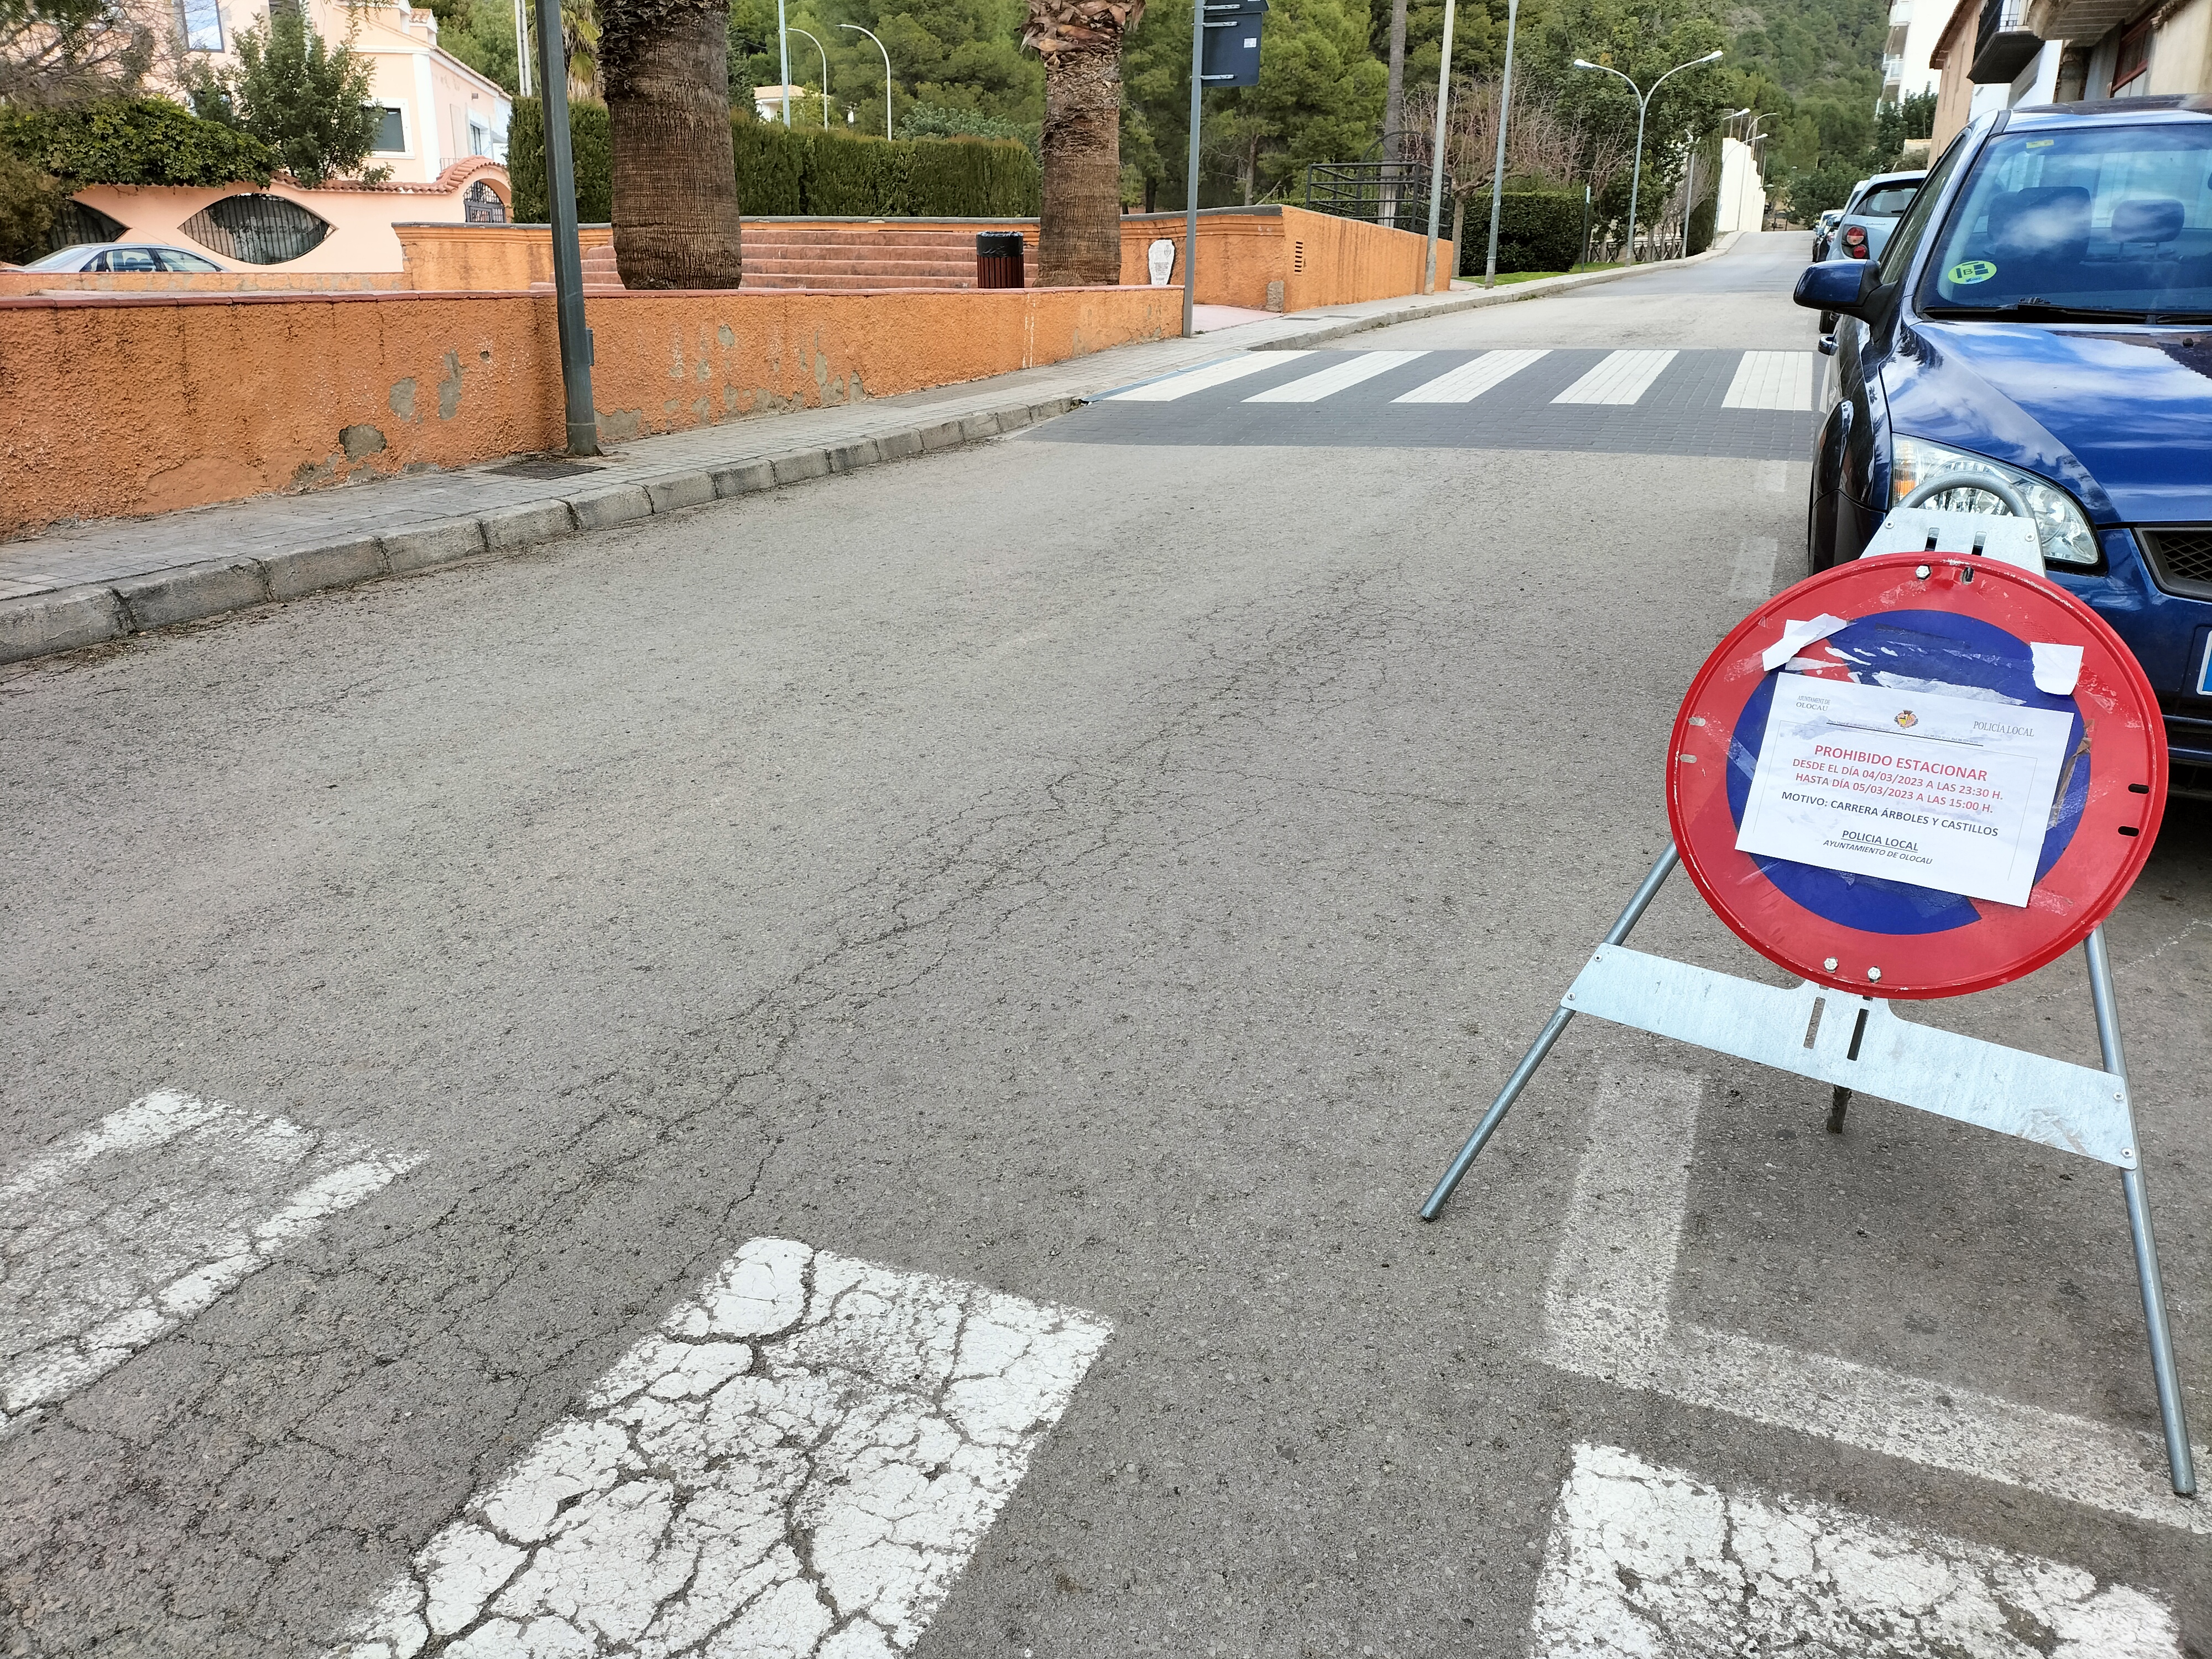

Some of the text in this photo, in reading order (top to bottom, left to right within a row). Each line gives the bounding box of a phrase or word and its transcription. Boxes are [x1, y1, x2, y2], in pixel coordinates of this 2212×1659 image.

[1796, 702, 1828, 711] OLOCAU
[1797, 695, 1824, 704] AJUNTAMENT
[1973, 721, 2034, 737] POLICÍA LOCAL
[1814, 745, 1987, 781] PROHIBIDO ESTACIONAR
[1793, 759, 2003, 800] DESDE EL DÍA 04/03/2023 A LAS 23:30 H.
[1796, 773, 1993, 813] HASTA DÍA 05/03/2023 A LAS 15:00 H.
[1781, 791, 1999, 837] MOTIVO: CARRERA ÁRBOLES Y CASTILLOS
[1823, 839, 1886, 855] AYUNTAMIENTO
[1899, 853, 1933, 865] OLOCAU
[1842, 830, 1918, 851] POLICIA LOCAL
